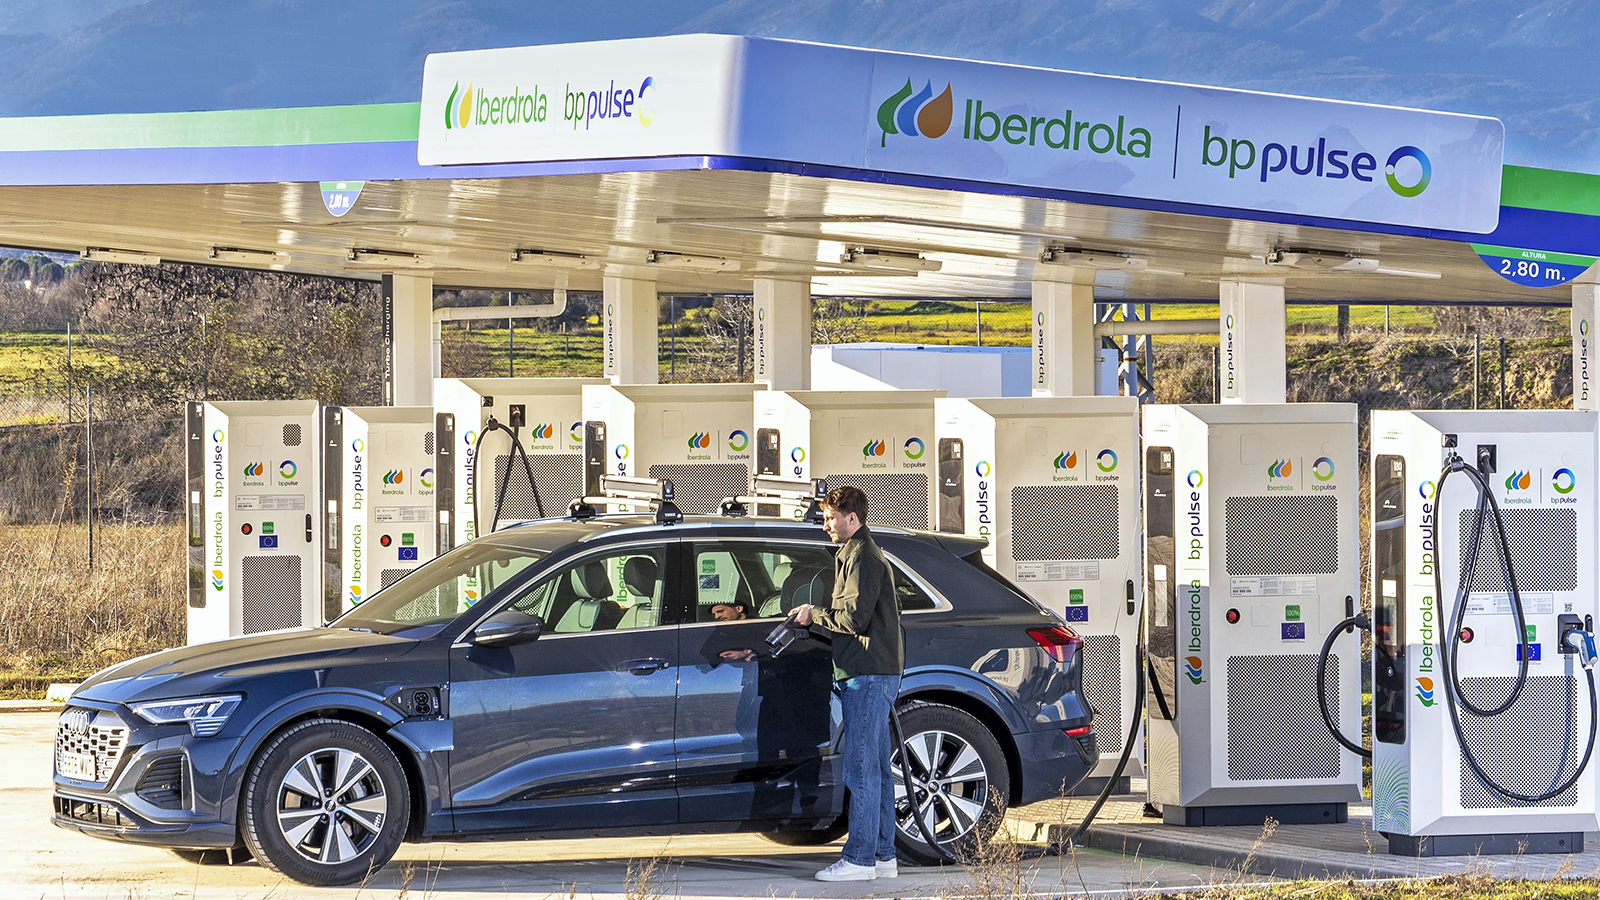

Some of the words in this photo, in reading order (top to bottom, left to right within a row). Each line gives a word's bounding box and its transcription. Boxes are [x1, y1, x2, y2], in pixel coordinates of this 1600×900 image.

[475, 84, 547, 126] Iberdrola
[963, 98, 1152, 158] Iberdrola
[1500, 259, 1539, 280] 2,80
[1545, 267, 1566, 282] m.
[1521, 251, 1546, 260] ALTURA
[1266, 484, 1294, 492] Iberdrola
[1504, 497, 1532, 505] Iberdrola
[213, 511, 223, 567] Iberdrola
[351, 524, 362, 582] Iberdrola
[1187, 579, 1201, 652] Iberdrola
[1419, 595, 1433, 673] Iberdrola
[328, 730, 390, 763] BRIDGESTONE
